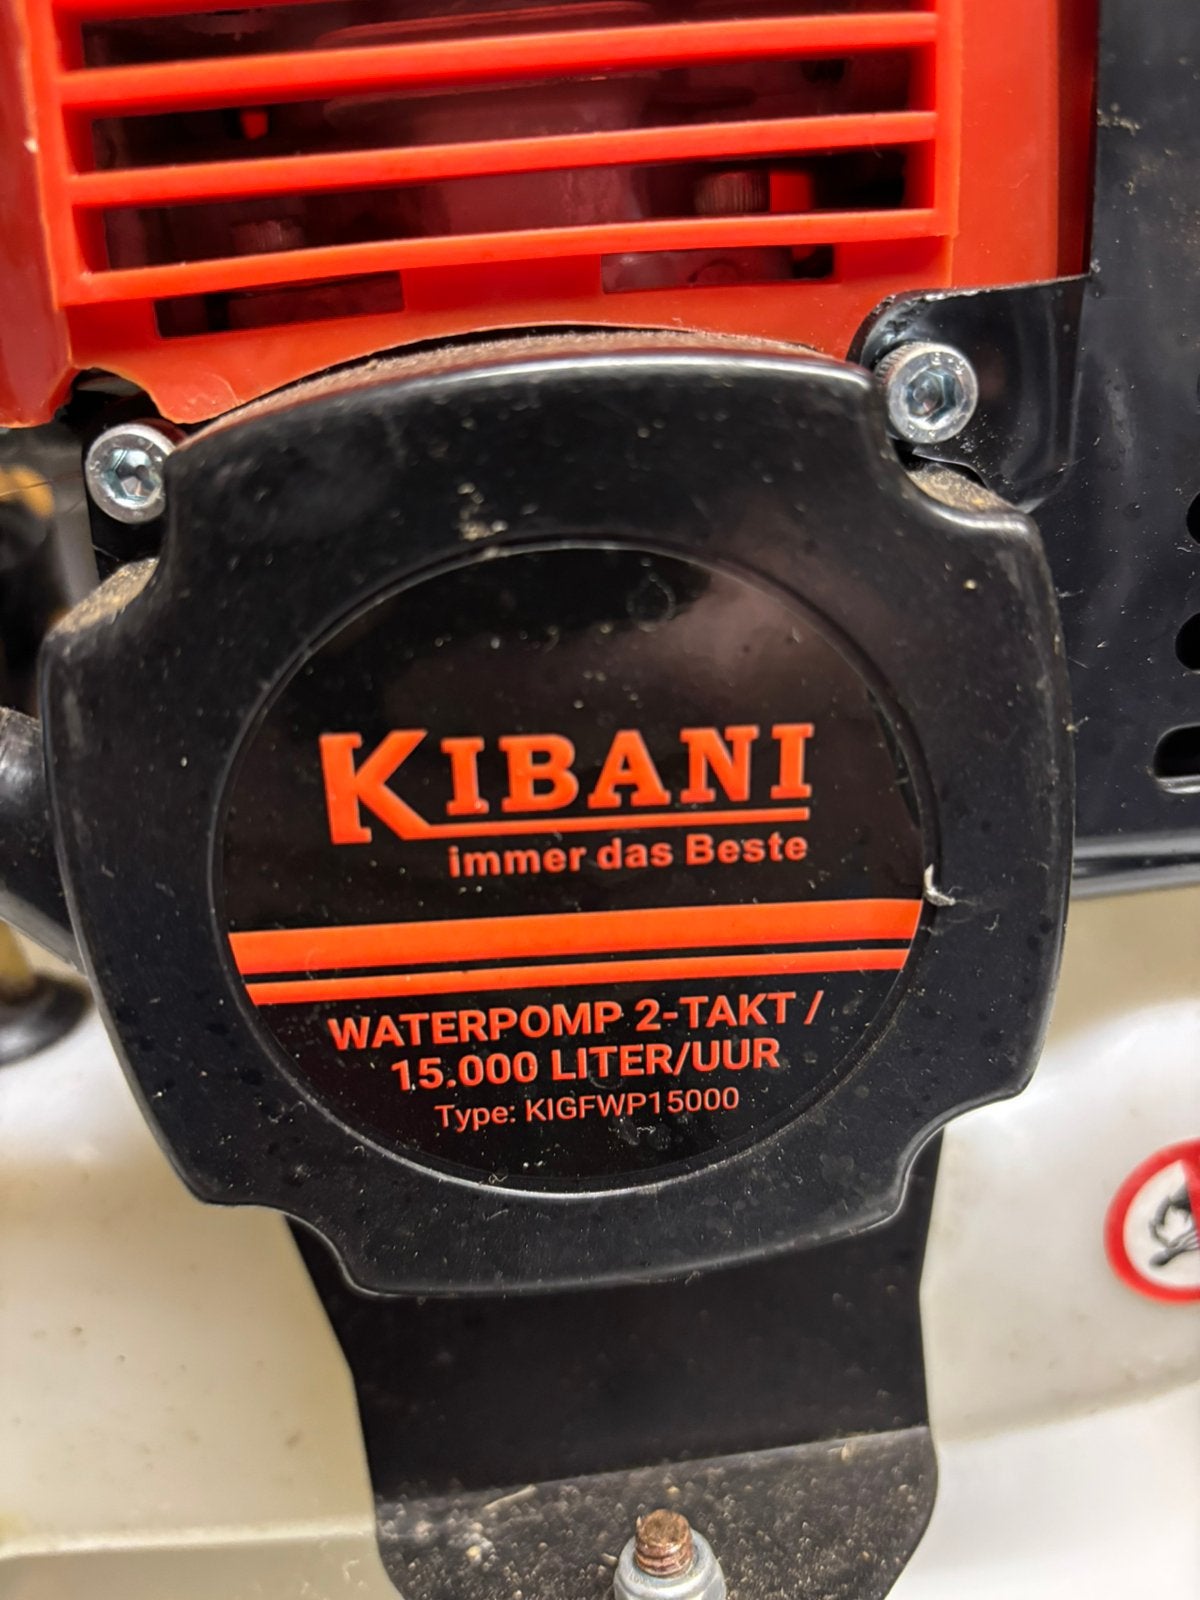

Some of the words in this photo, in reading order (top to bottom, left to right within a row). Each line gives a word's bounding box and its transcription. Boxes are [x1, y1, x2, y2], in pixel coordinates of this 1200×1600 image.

[320, 722, 815, 845] KIBANI
[448, 845, 587, 878] immer
[597, 837, 674, 870] das
[686, 832, 808, 866] Beste
[327, 1001, 622, 1051] WATERPOMP
[634, 991, 796, 1033] 2-TAKT
[803, 990, 823, 1026] /
[390, 1052, 538, 1091] 15.000
[551, 1037, 780, 1082] LITER/UUR
[434, 1104, 517, 1133] Type:
[525, 1087, 739, 1122] KIGFWP15000
